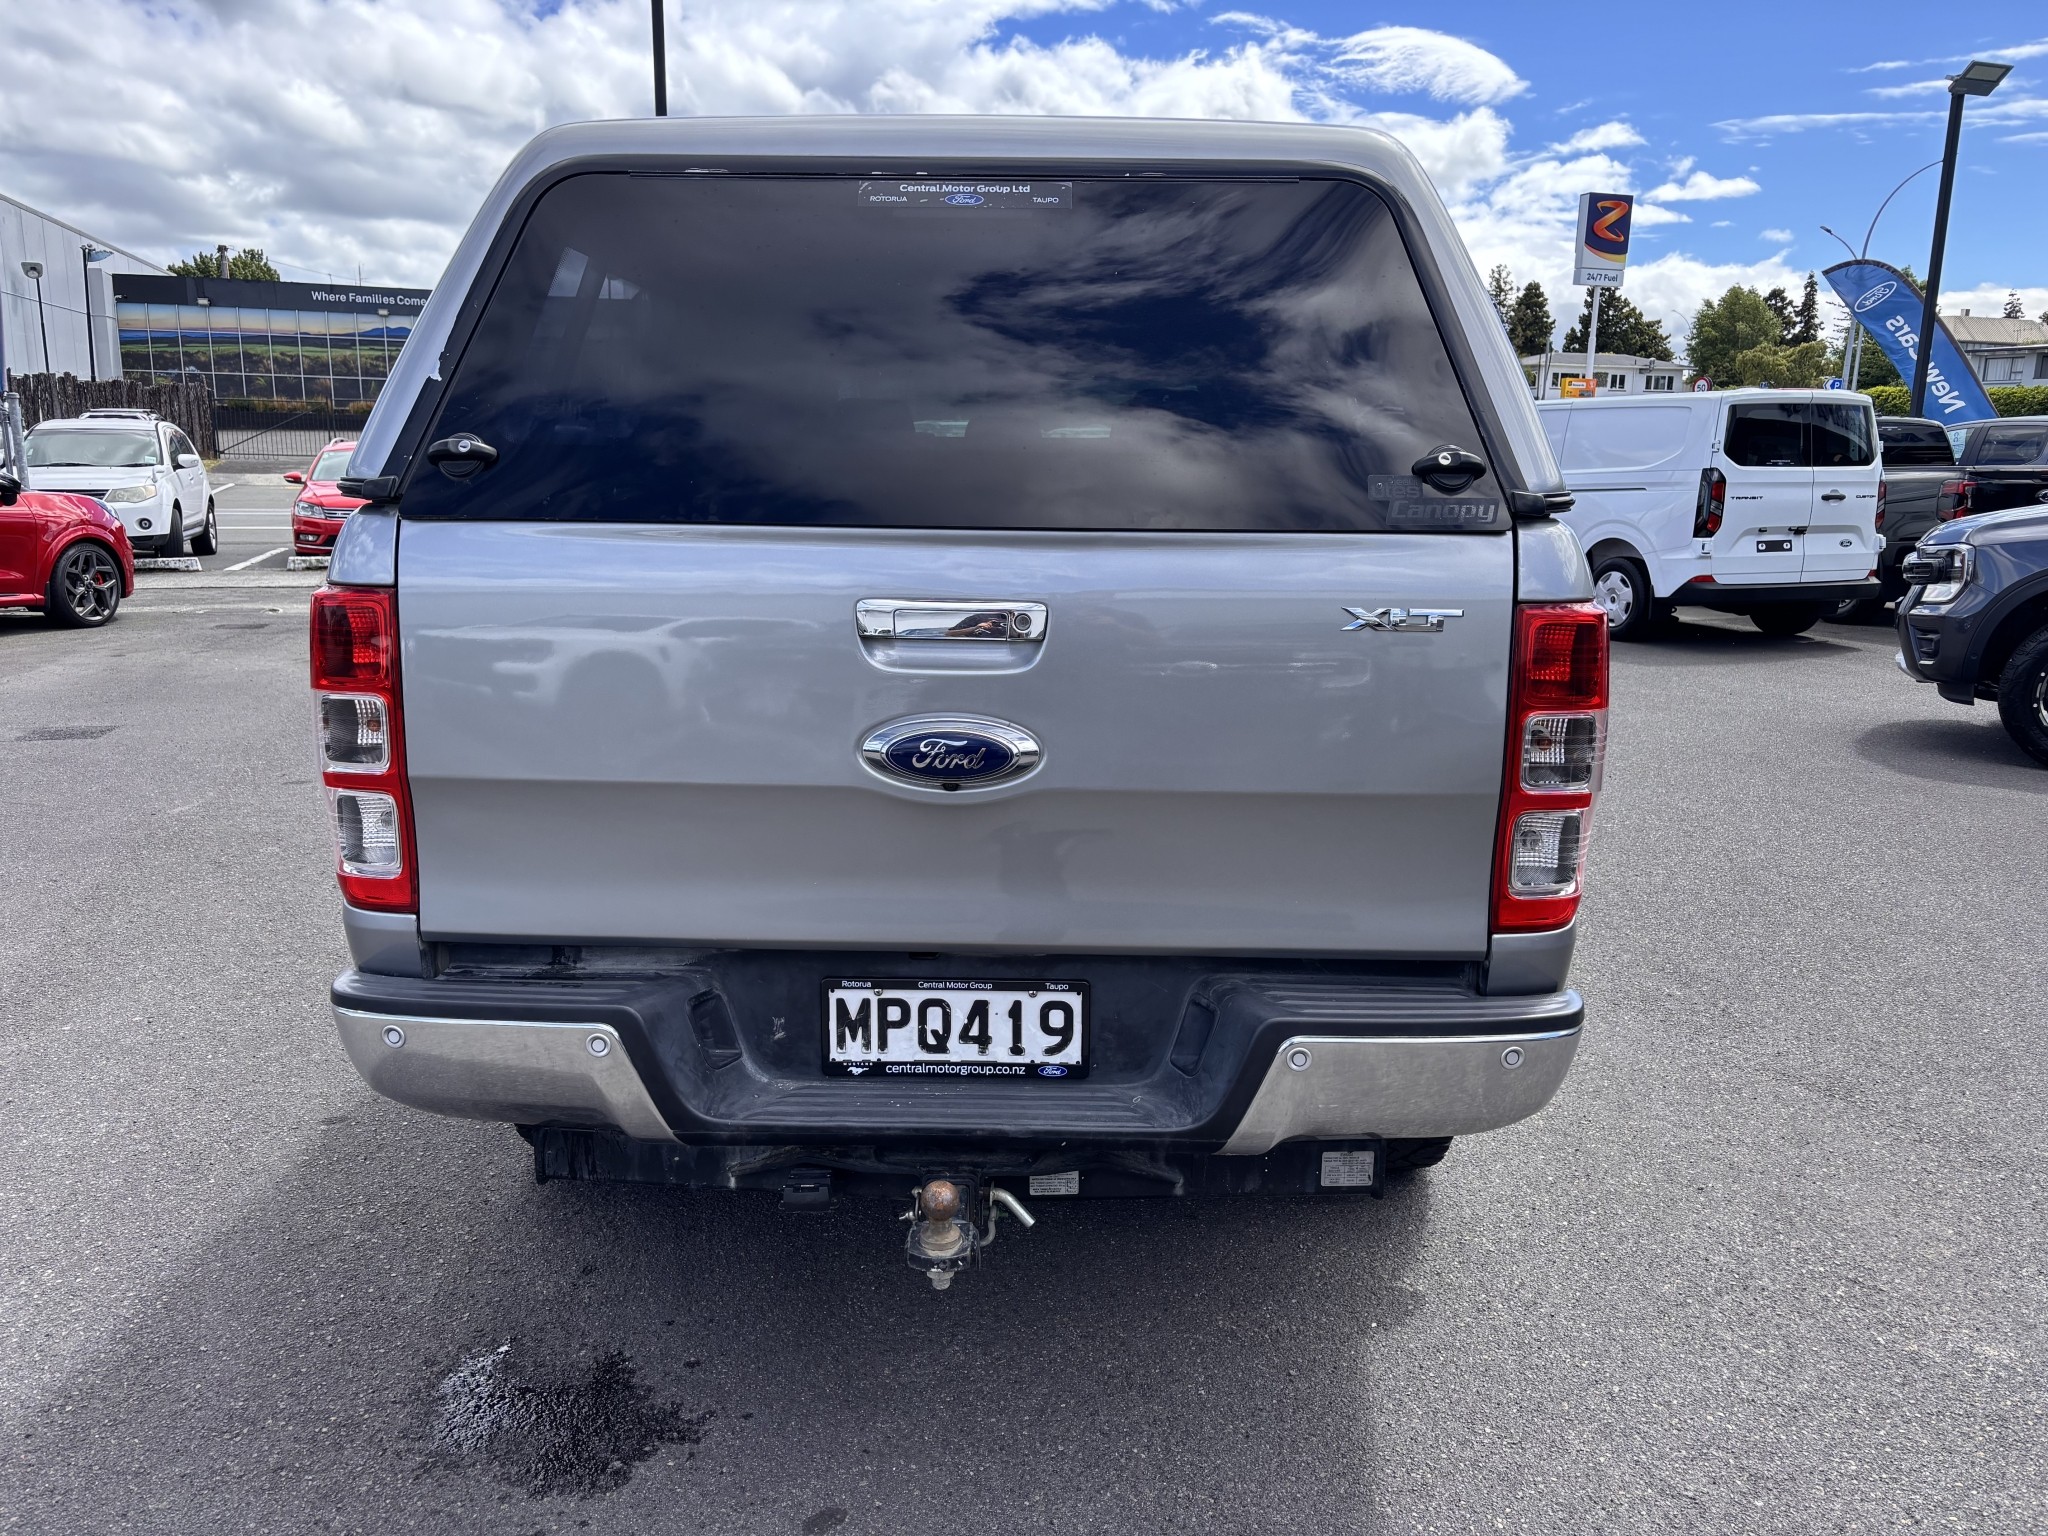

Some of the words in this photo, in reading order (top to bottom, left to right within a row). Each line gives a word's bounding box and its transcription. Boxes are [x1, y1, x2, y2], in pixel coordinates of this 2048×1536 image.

[900, 184, 940, 193] Central
[942, 184, 975, 193] Motor
[976, 185, 1010, 194] Group
[1012, 185, 1031, 193] Ltd
[951, 195, 976, 204] Ford
[1593, 200, 1629, 243] Z
[1586, 273, 1603, 281] 24/7
[1603, 274, 1619, 282] Fuel
[311, 291, 347, 302] Where
[348, 292, 395, 304] Families
[396, 295, 427, 306] Come
[1696, 383, 1706, 392] 50
[1834, 381, 1840, 389] P
[1391, 500, 1495, 523] Canopy
[1340, 606, 1464, 632] XLT
[912, 738, 986, 770] Ford
[841, 980, 872, 988] Rotorua
[918, 981, 945, 989] Central
[970, 982, 993, 990] Group
[1045, 983, 1069, 991] Taupo
[835, 997, 1075, 1056] MPQ419
[885, 1064, 1026, 1076] centralmotorgroup.co.nz
